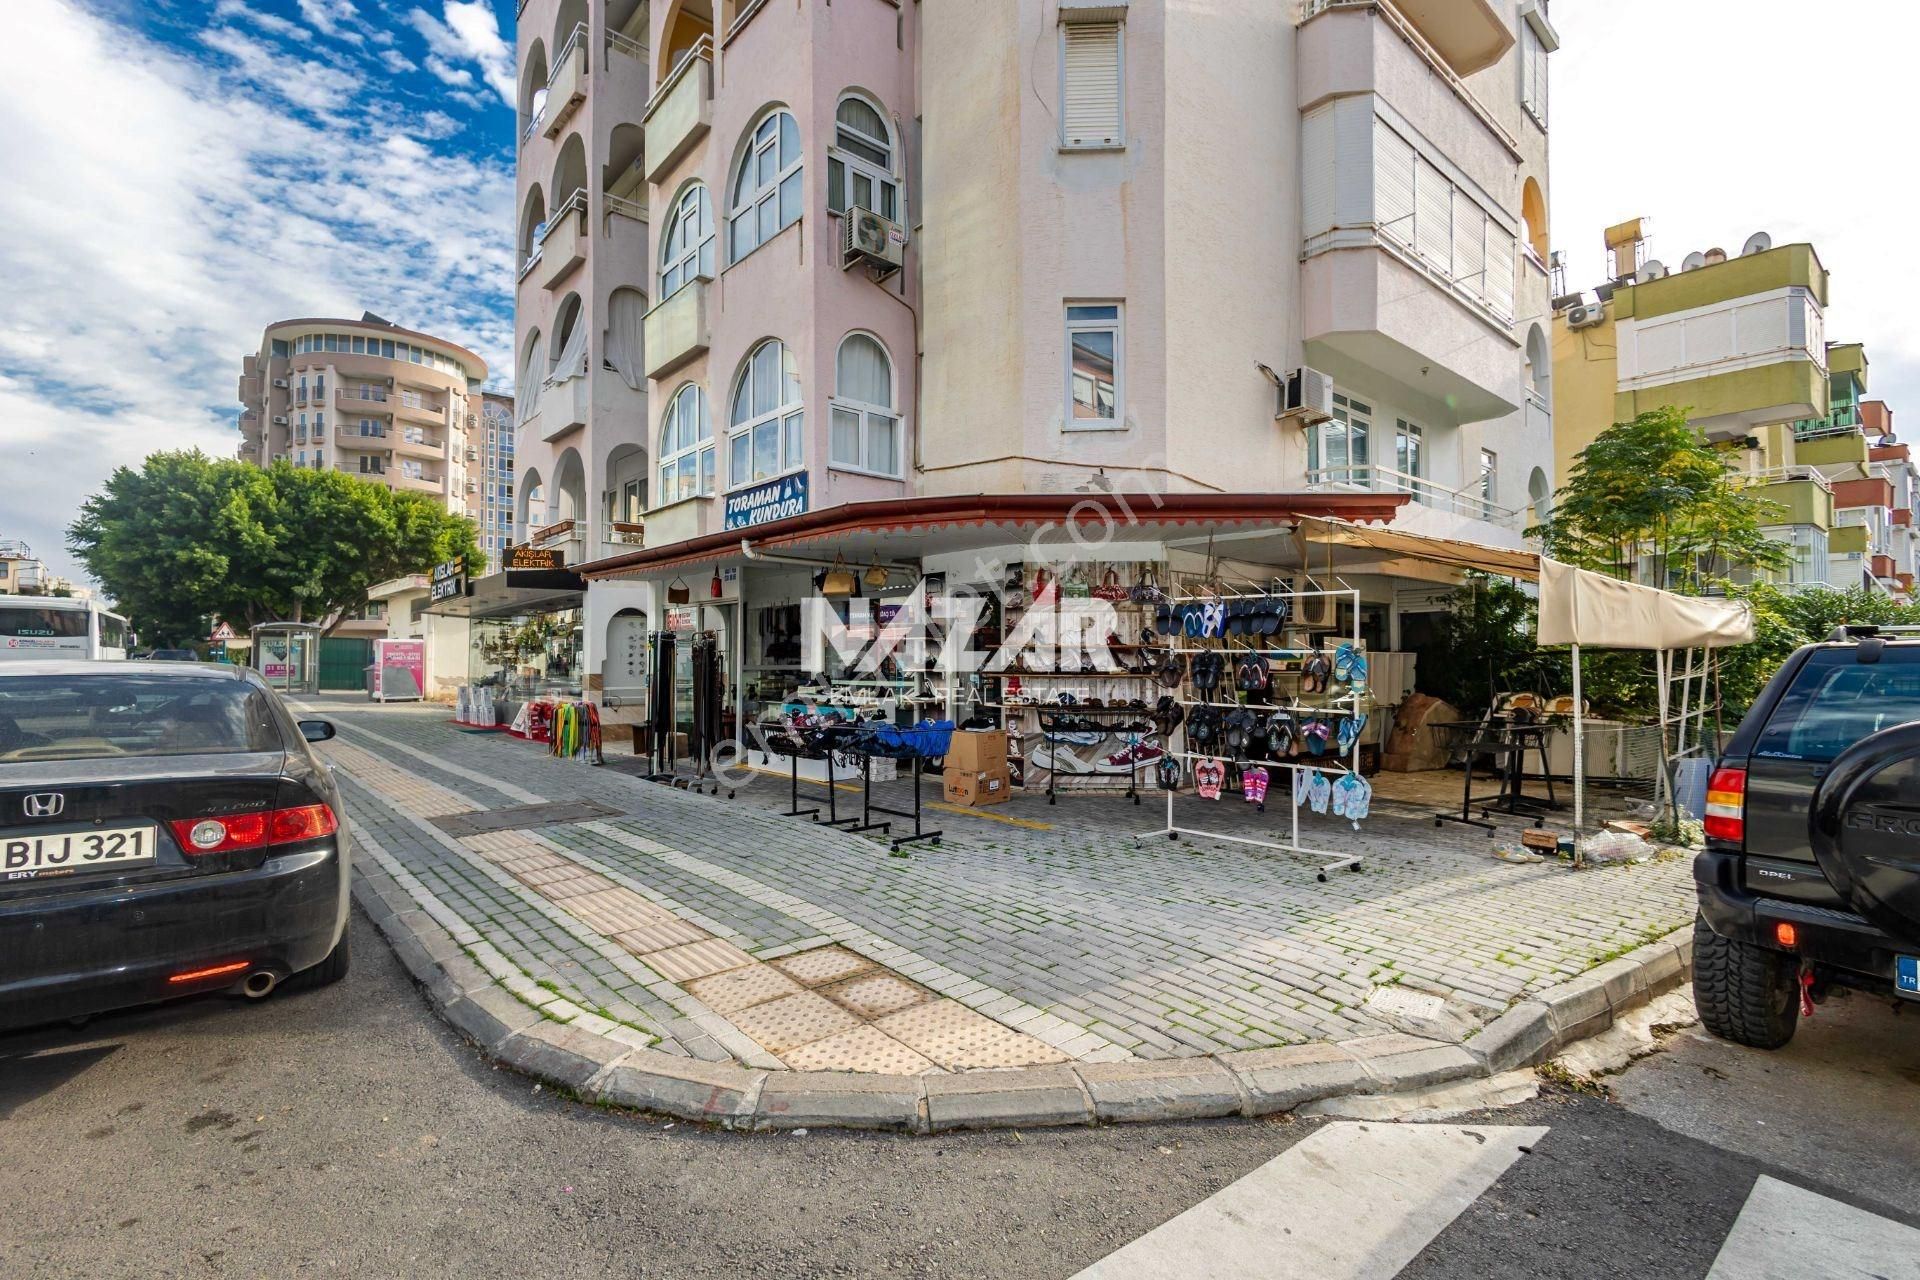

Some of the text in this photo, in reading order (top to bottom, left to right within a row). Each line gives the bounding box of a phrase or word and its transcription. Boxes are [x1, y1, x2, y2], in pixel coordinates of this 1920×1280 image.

[728, 485, 781, 514] TORAMAN
[749, 496, 803, 525] KUNDURA
[5, 830, 143, 868] BIJ 321
[8, 870, 38, 880] ERY
[1758, 869, 1796, 881] OPEL
[1902, 975, 1916, 985] TR
